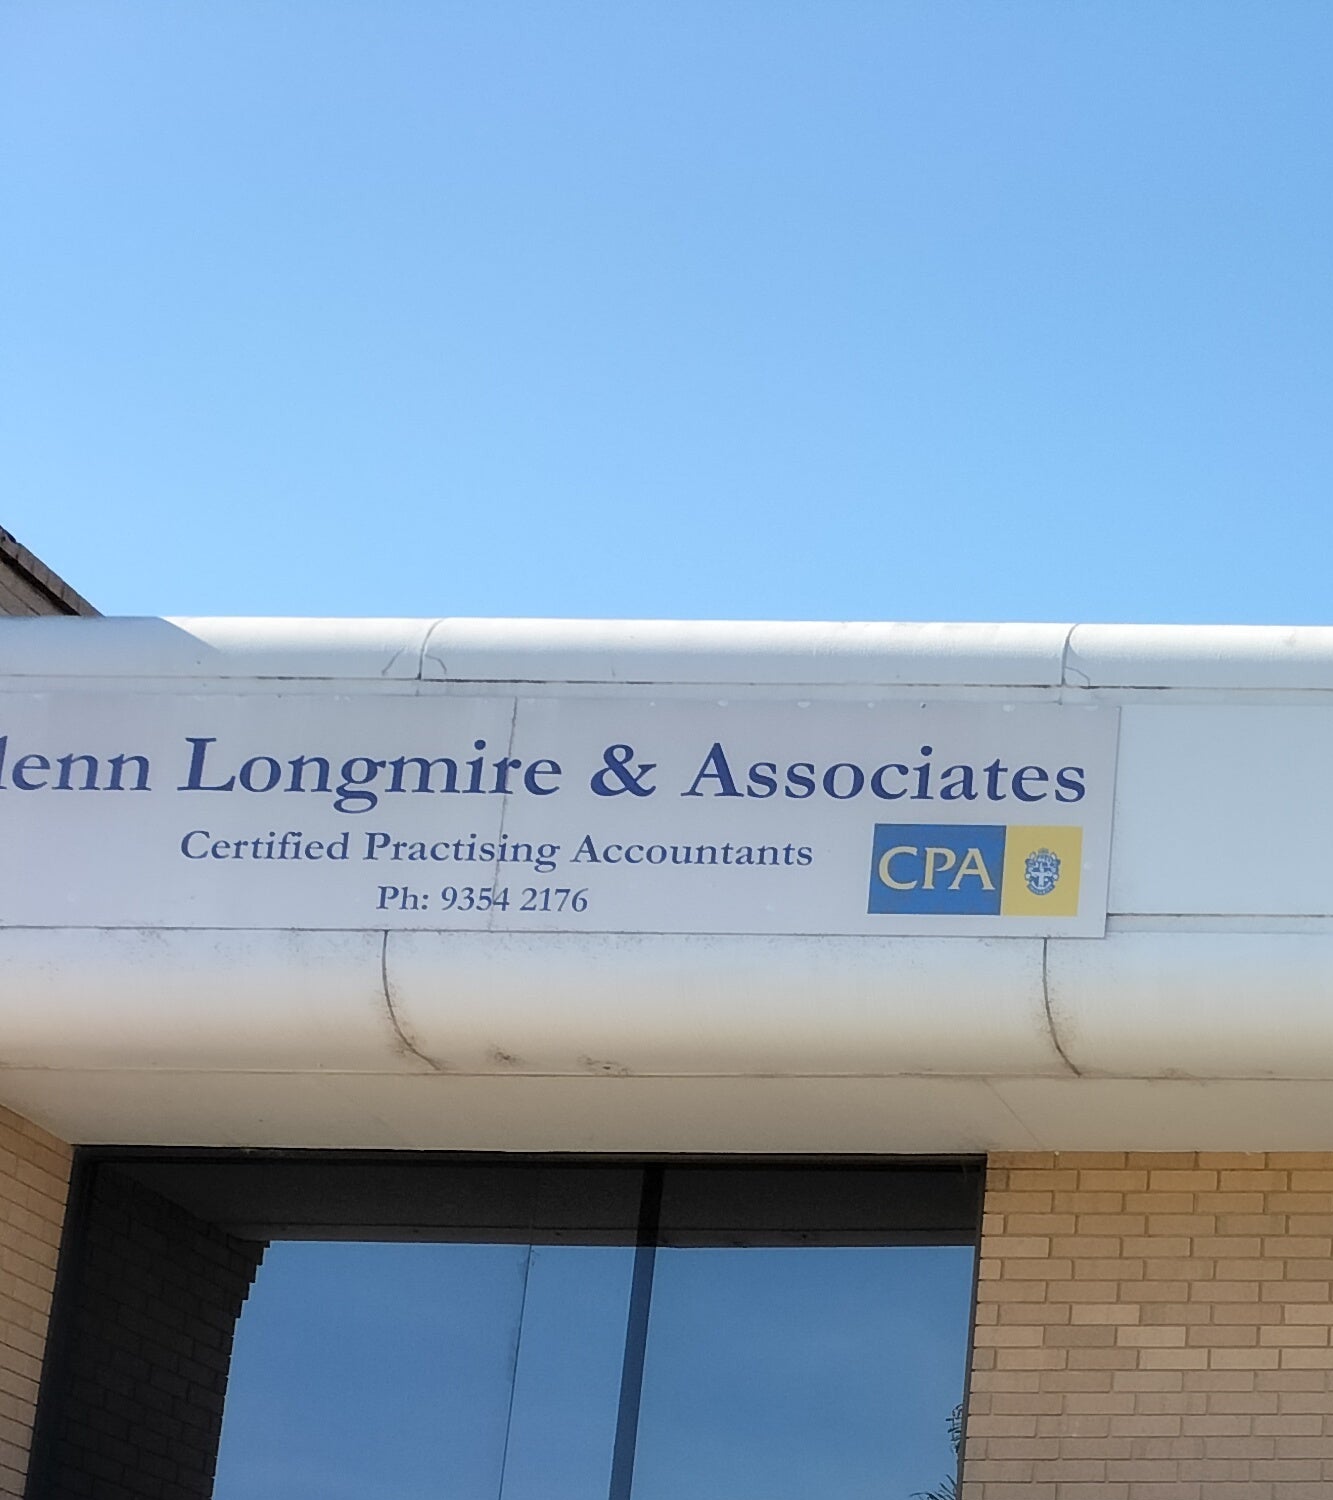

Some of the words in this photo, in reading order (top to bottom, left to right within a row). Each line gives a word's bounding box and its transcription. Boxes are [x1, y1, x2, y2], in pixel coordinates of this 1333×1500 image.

[177, 737, 562, 814] Longmire
[590, 744, 657, 797] &
[681, 743, 1085, 802] Associates
[180, 830, 349, 862] Certified
[365, 832, 560, 873] Practising
[570, 834, 813, 866] Accountants
[878, 846, 995, 891] CPA
[377, 885, 429, 912] Ph:
[441, 886, 510, 912] 9354
[520, 888, 588, 913] 2176
